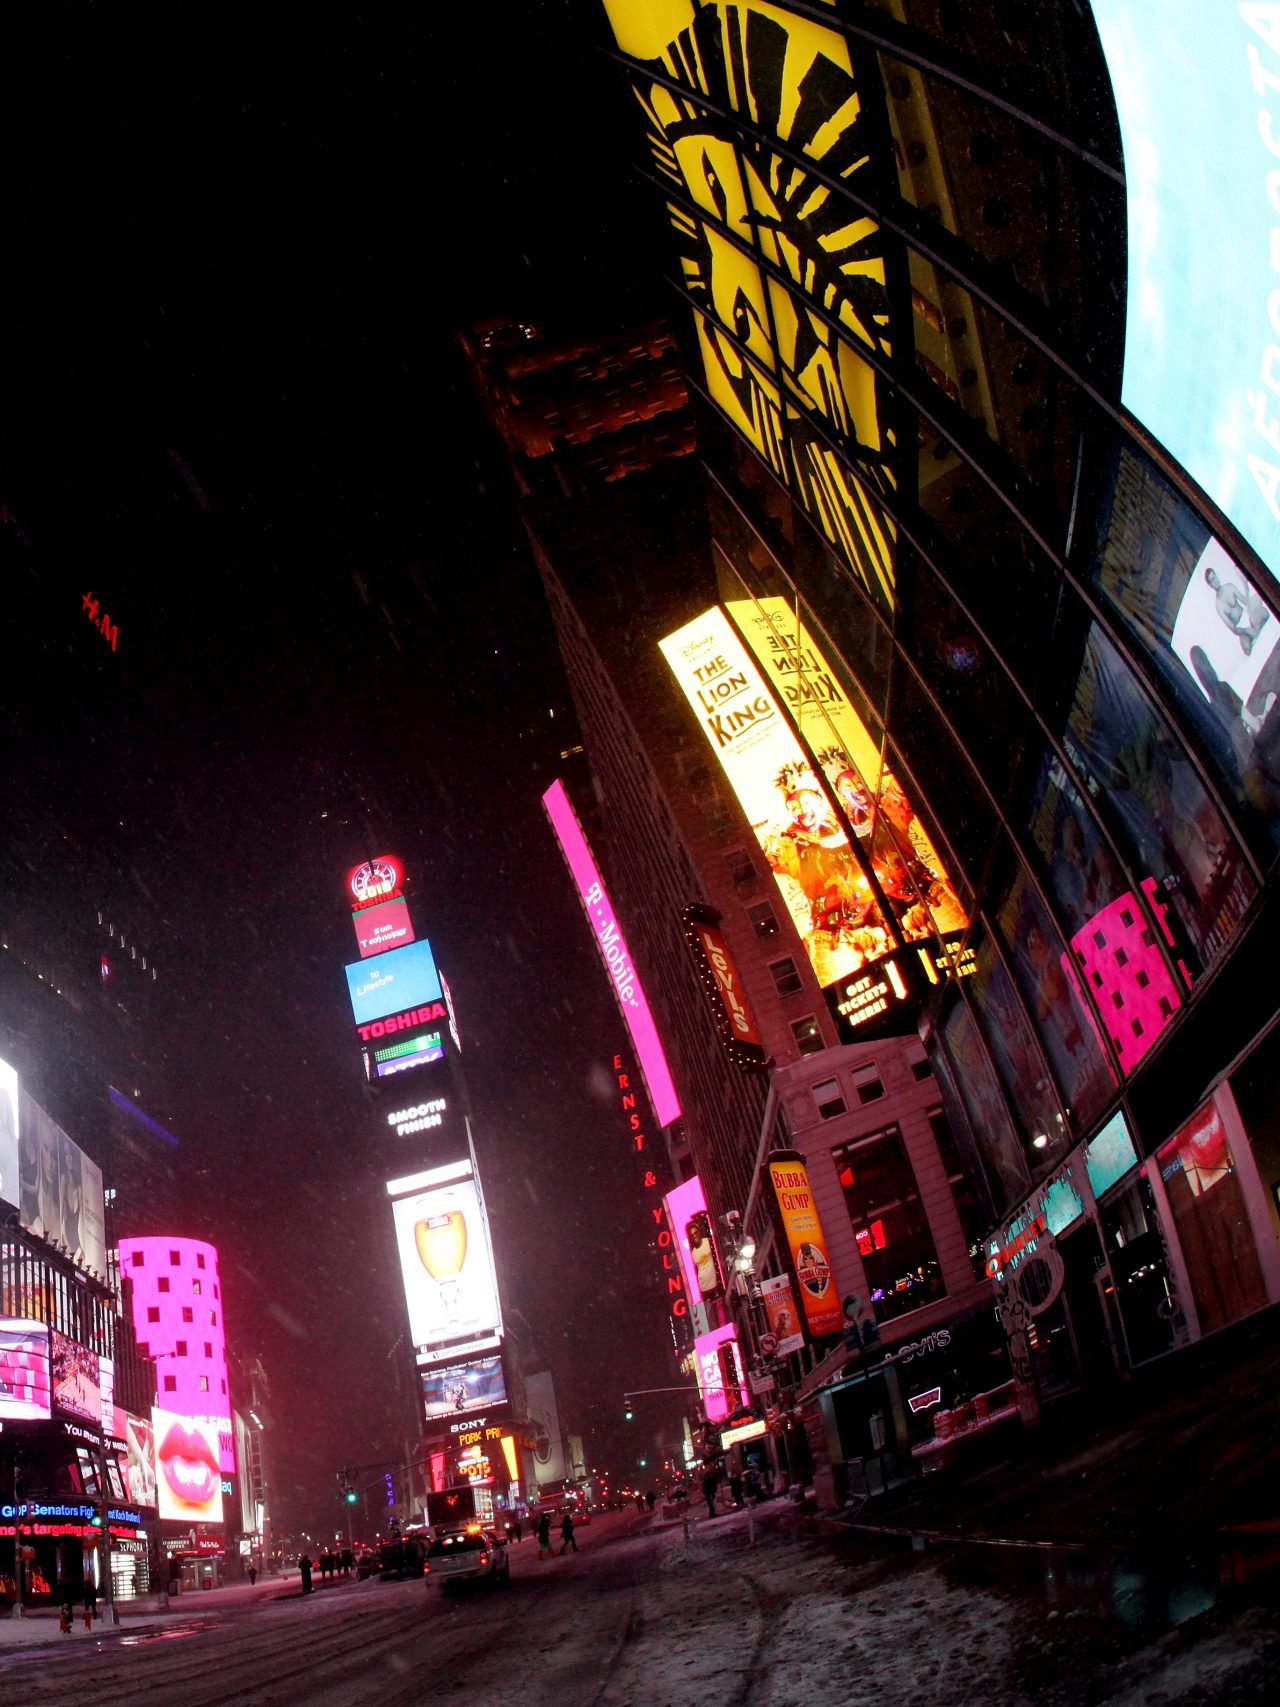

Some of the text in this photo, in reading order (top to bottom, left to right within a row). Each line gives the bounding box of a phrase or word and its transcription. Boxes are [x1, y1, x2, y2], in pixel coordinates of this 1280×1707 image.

[81, 591, 118, 653] H&M
[692, 654, 729, 682] THE
[696, 671, 748, 715] LION
[707, 696, 772, 748] KING
[352, 888, 403, 912] TOSHIBA
[361, 927, 407, 949] Technology
[356, 974, 394, 997] Lifestyle
[369, 970, 380, 980] to
[846, 976, 872, 997] GET
[838, 982, 888, 1017] TICKETS
[358, 1002, 447, 1042] TOSHIBA
[849, 998, 889, 1027] HERE!
[387, 1098, 446, 1126] SMOOTH
[613, 1054, 645, 1151] ERNST
[644, 1171, 657, 1188] &
[397, 1113, 442, 1137] FINISH
[772, 1168, 808, 1190] BUBBA
[781, 1192, 810, 1212] GUMP
[703, 1366, 723, 1382] CA
[65, 1423, 82, 1436] You
[450, 1418, 487, 1433] SONY
[459, 1431, 481, 1446] PORK
[120, 1542, 144, 1552] SEPHORA
